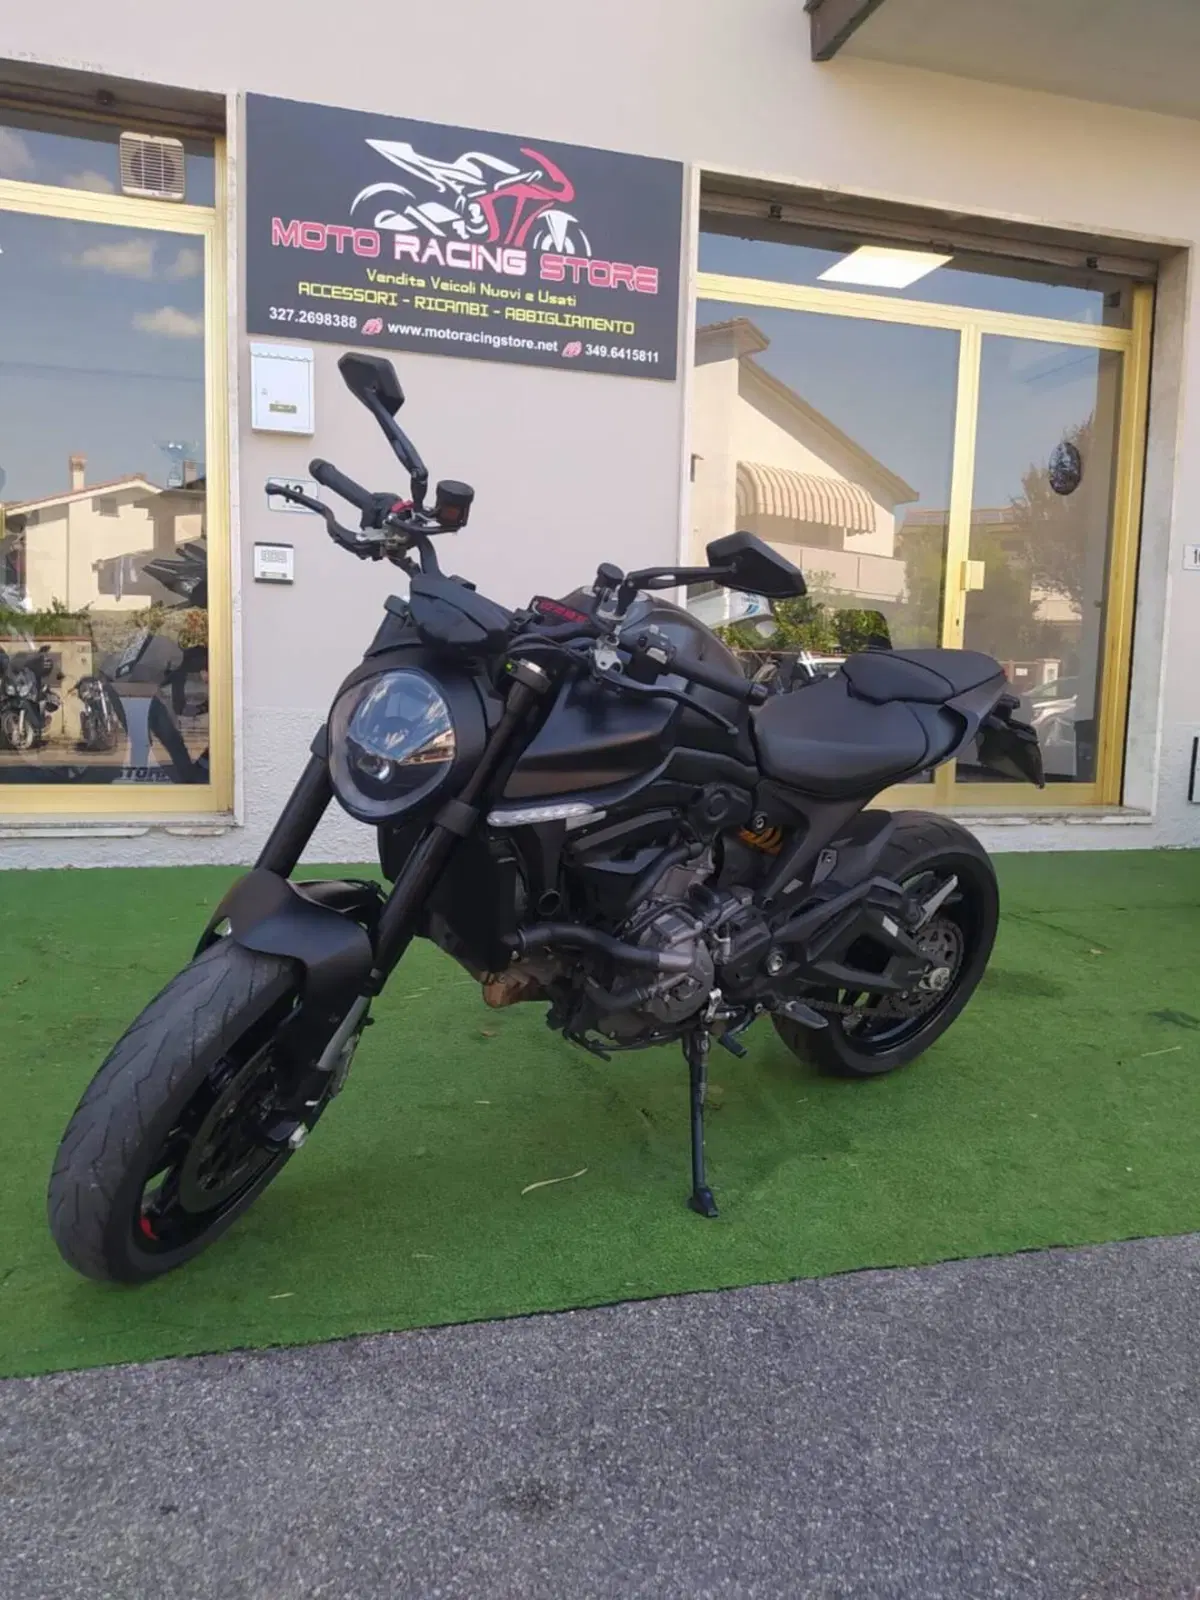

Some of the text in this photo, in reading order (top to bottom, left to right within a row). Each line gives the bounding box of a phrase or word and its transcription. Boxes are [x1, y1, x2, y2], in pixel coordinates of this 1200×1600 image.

[271, 216, 658, 295] MOTO RACING STORE
[298, 281, 398, 307] ACCESSORI
[414, 295, 489, 317] RICAMBI
[505, 306, 635, 335] ABBIGLIAMENTO
[366, 267, 577, 307] Vendita Veicoli Nuovi e Usati
[269, 306, 659, 363] 327.2698388 www.motoracingstore.net 349.6415811
